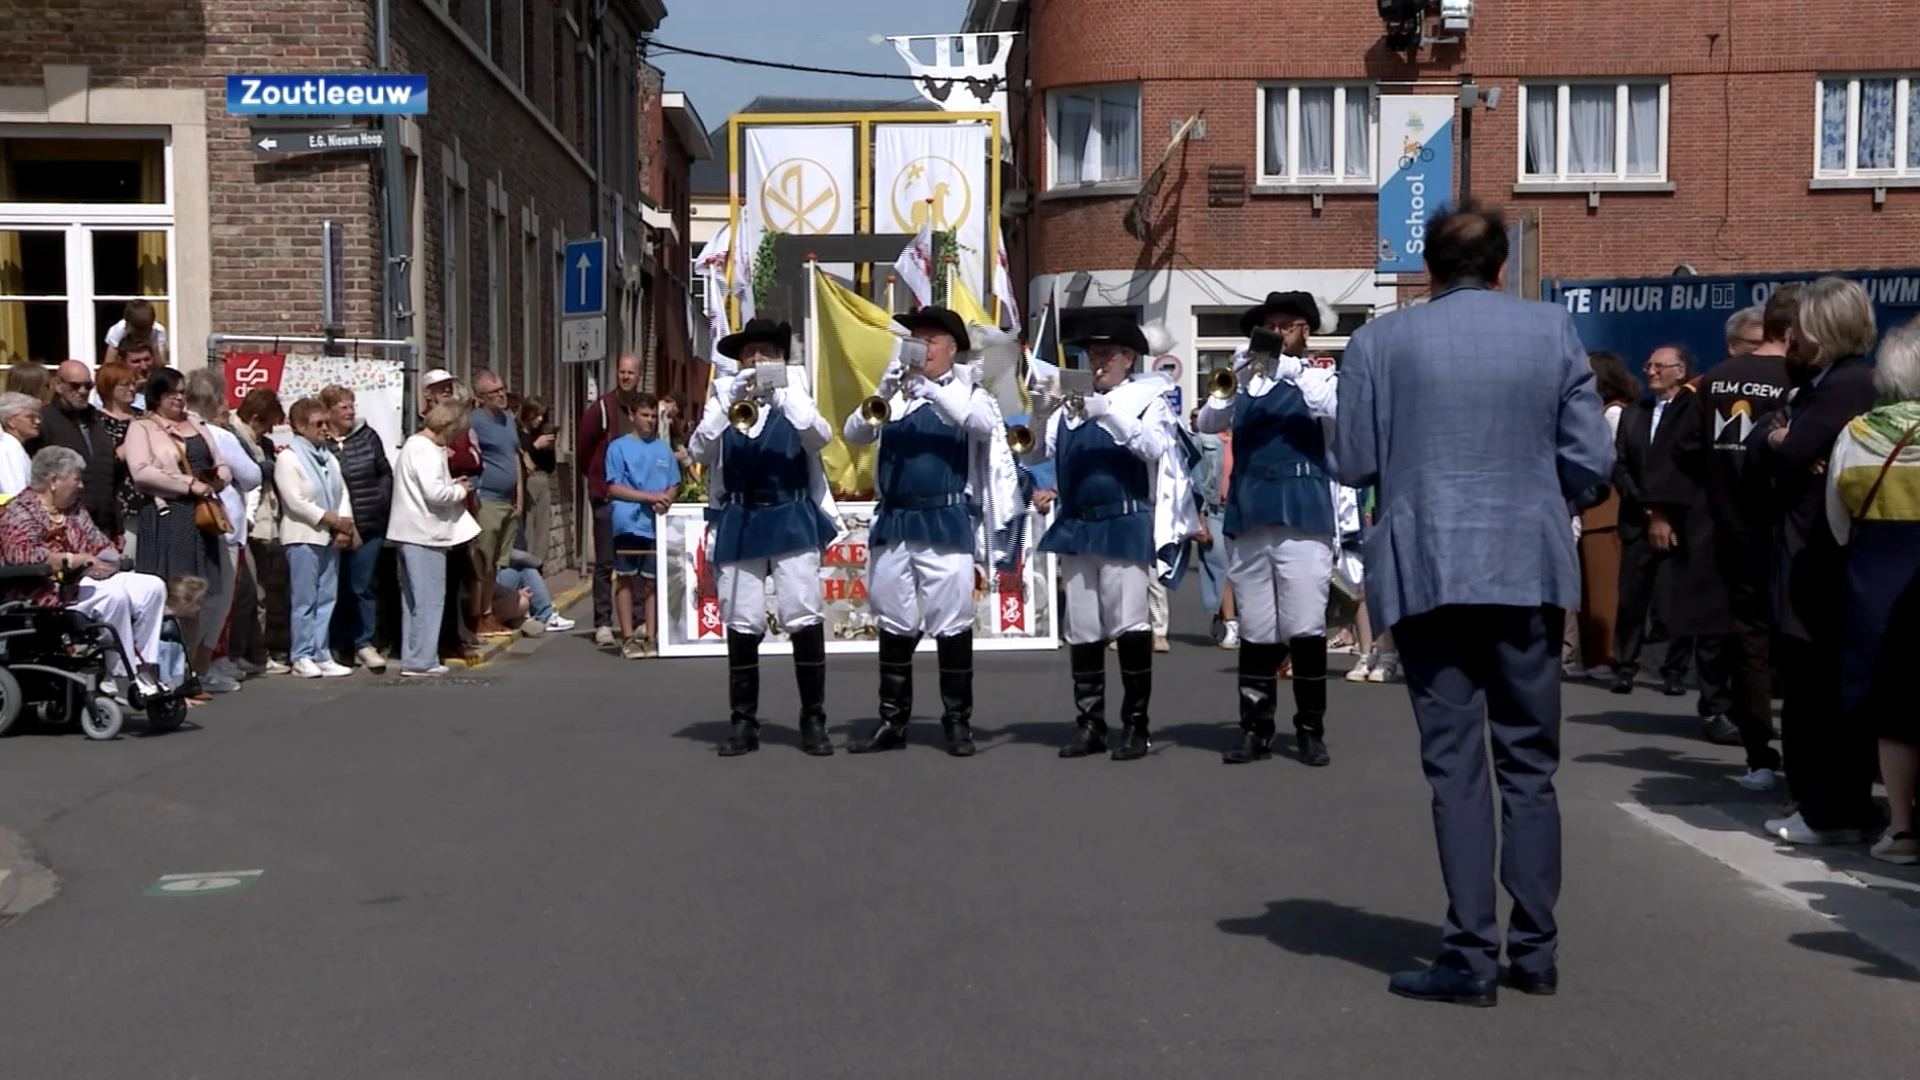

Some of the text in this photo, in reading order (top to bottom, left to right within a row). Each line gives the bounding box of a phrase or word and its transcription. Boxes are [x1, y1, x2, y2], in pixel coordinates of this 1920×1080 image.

[309, 132, 383, 148] E.G. Nieuwe Hoop
[1405, 173, 1425, 254] School
[1564, 288, 1592, 314] TE
[1600, 286, 1663, 313] HUUR
[1670, 284, 1708, 311] BIJ
[1711, 381, 1784, 399] FILM CREW
